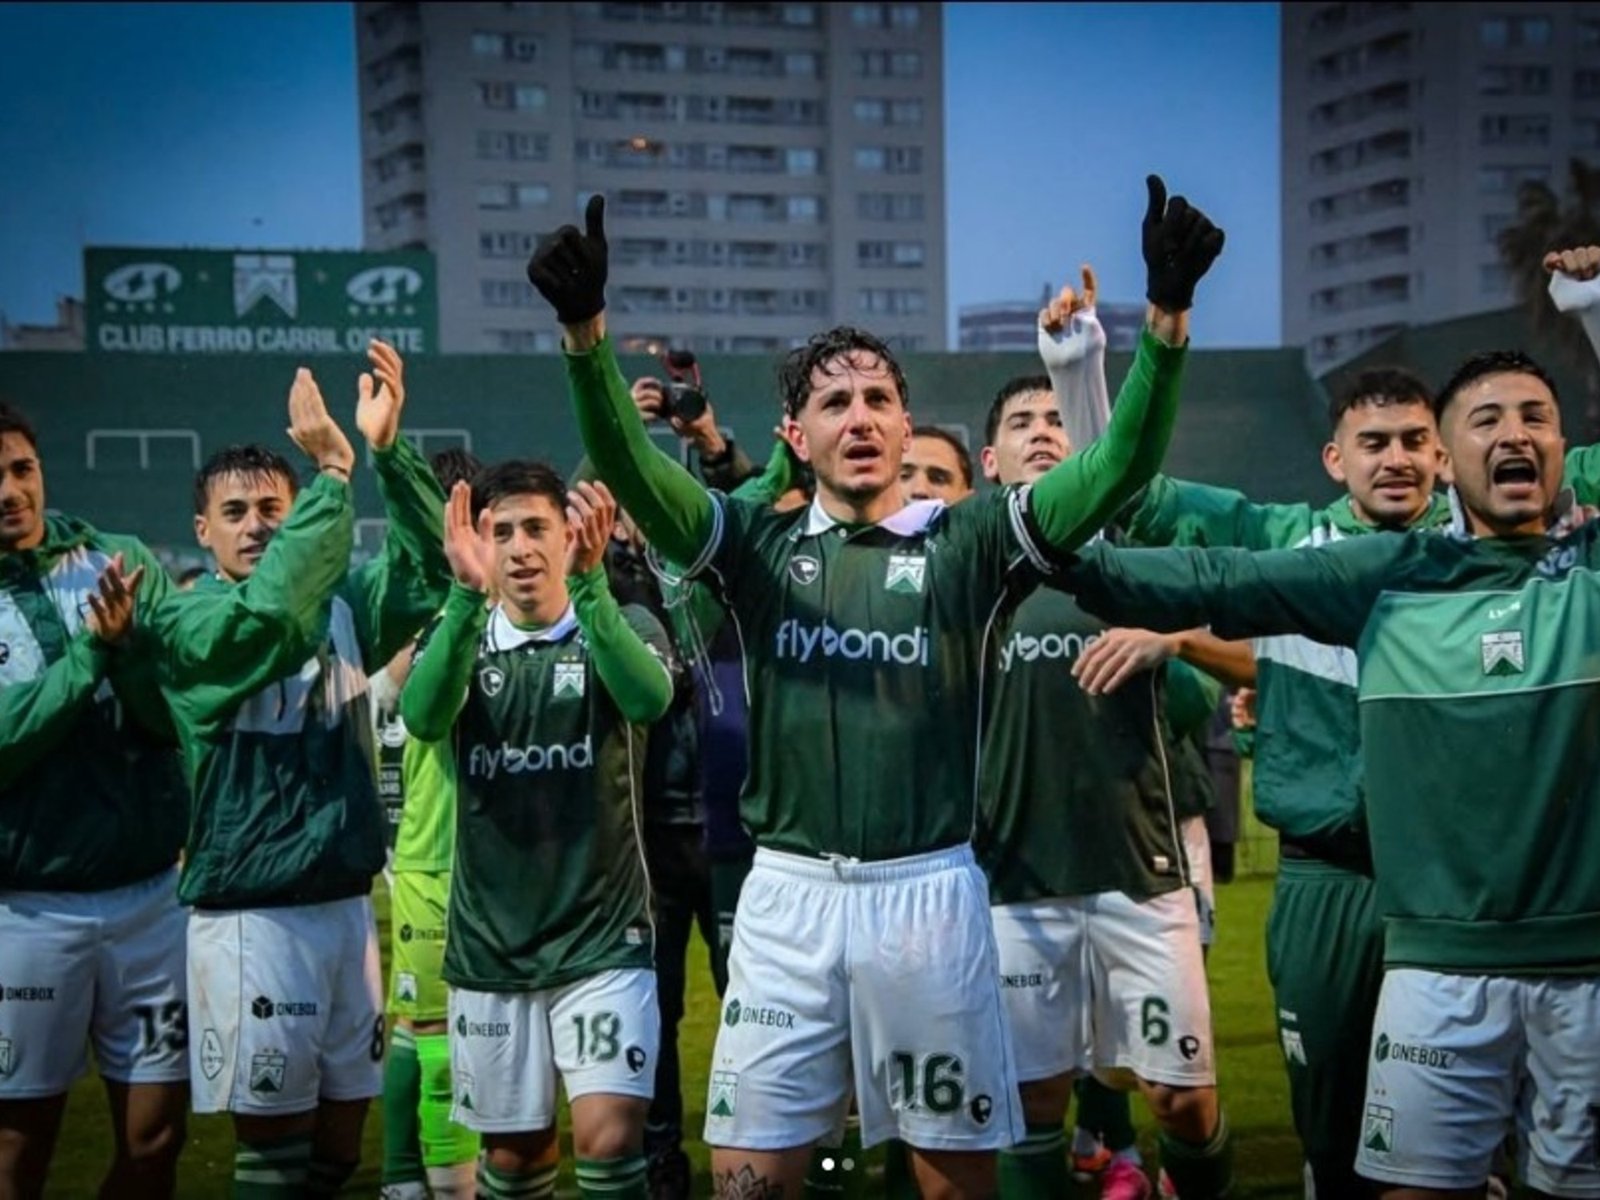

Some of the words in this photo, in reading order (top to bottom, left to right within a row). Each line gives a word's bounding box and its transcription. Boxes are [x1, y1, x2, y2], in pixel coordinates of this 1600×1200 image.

[100, 324, 165, 351] CLUB
[168, 326, 252, 351] FERRO
[256, 327, 342, 351] CARRIL
[776, 618, 930, 667] flybondi
[999, 629, 1107, 673] ybon
[469, 734, 594, 780] flybond
[6, 985, 55, 1002] ONEBOX
[1000, 972, 1043, 989] ONEBOX
[468, 1021, 512, 1039] ONEBOX
[742, 1008, 796, 1030] ONEBOX
[1141, 996, 1171, 1046] 6
[572, 1012, 622, 1063] 18
[1391, 1041, 1451, 1070] ONEBOX
[888, 1051, 964, 1113] 16
